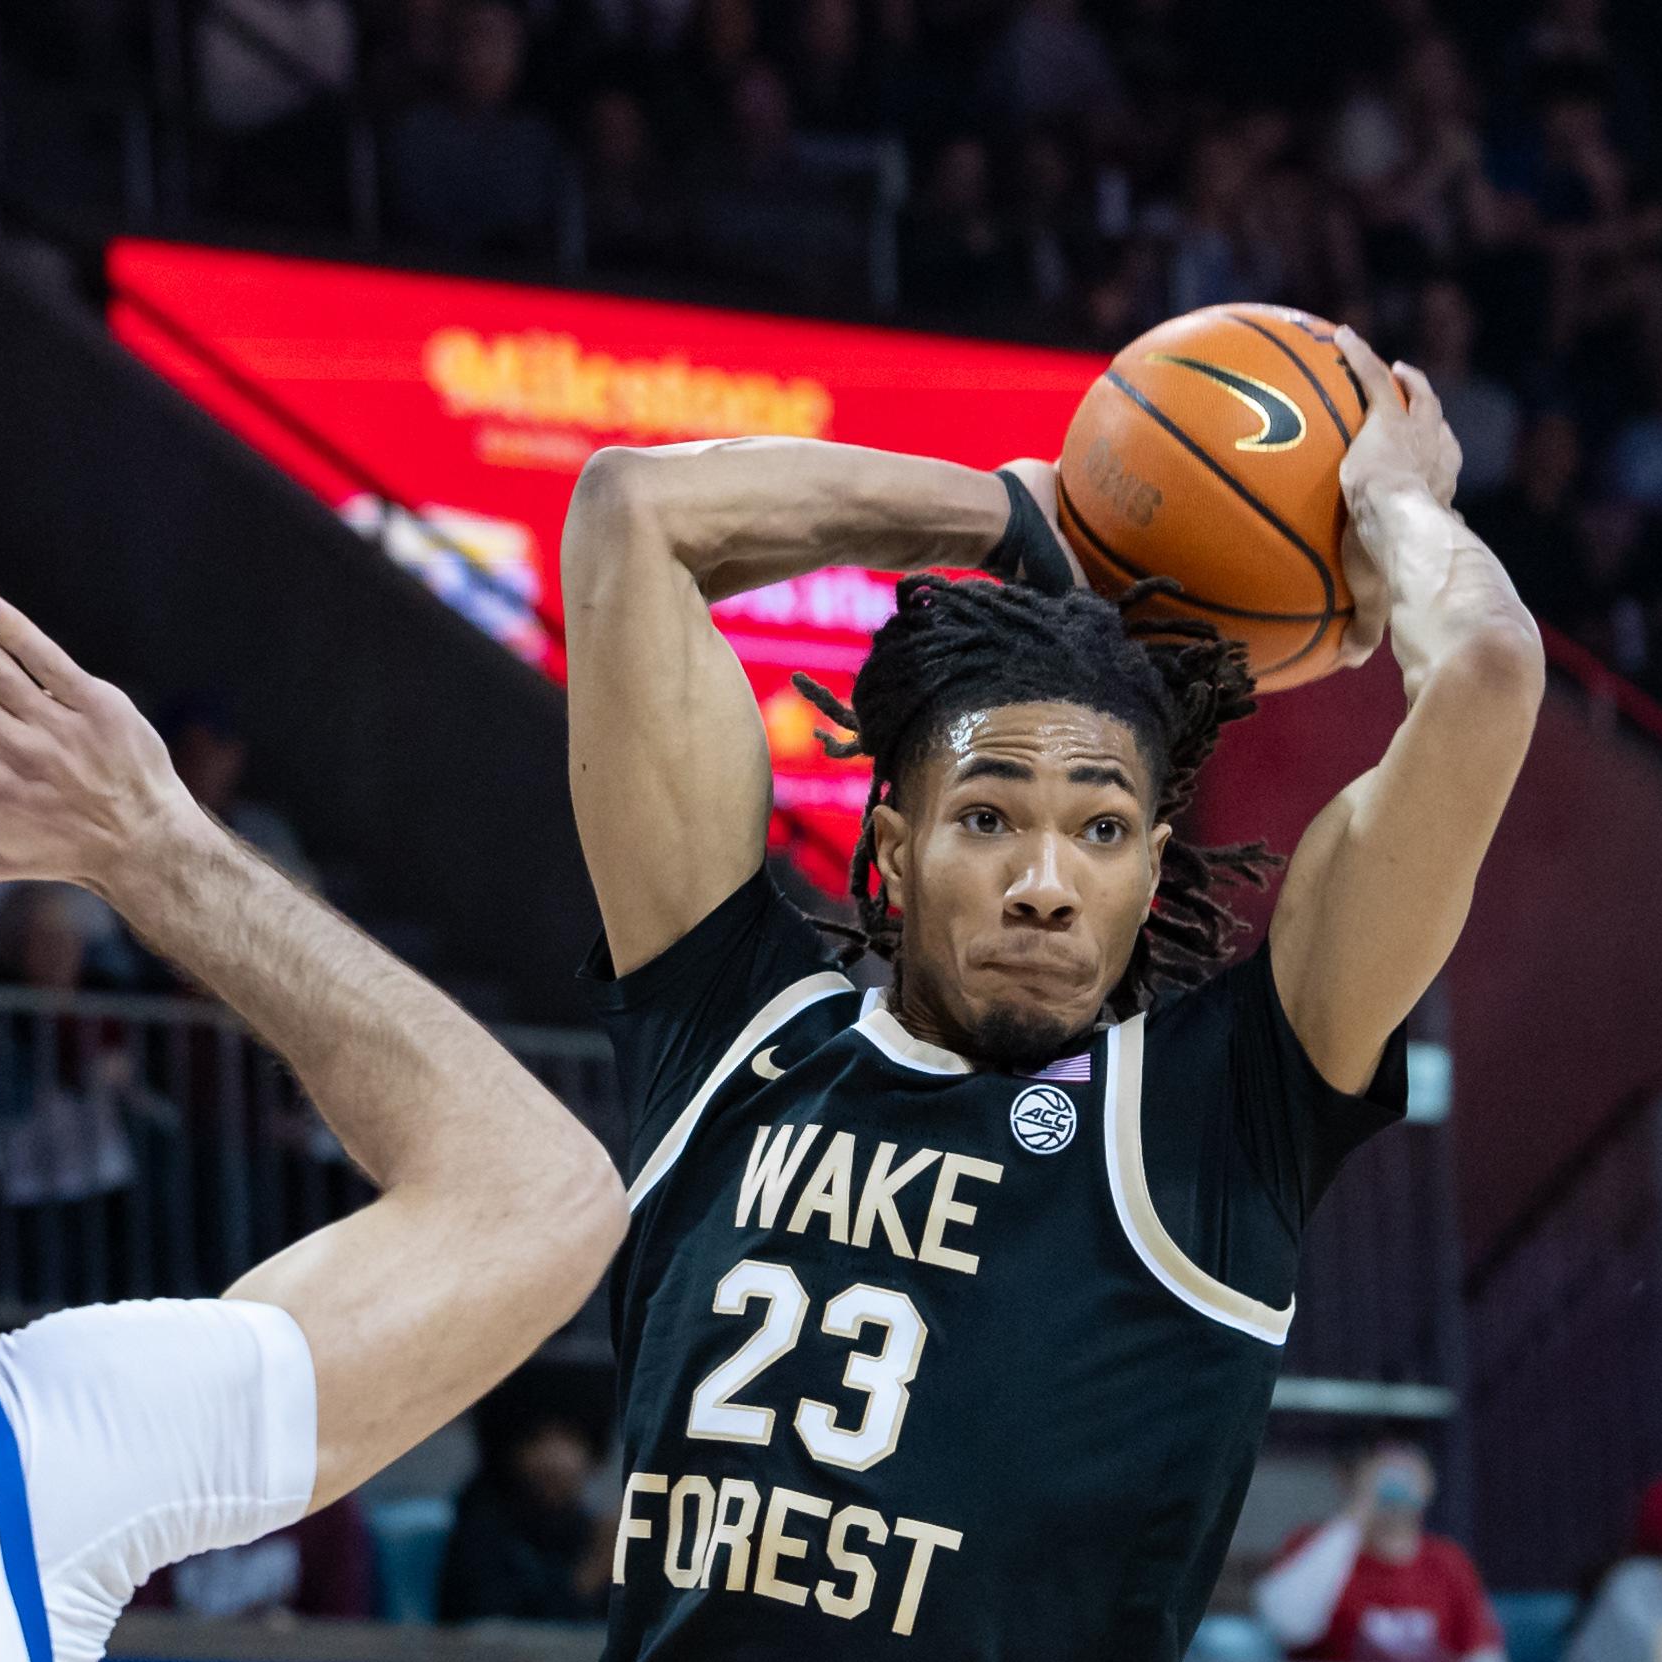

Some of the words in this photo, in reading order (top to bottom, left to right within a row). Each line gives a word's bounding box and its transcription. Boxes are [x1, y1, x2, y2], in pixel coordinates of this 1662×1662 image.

[1021, 1106, 1073, 1132] ACC
[734, 1124, 1005, 1276] WAKE
[687, 1259, 928, 1472] 23
[613, 1472, 963, 1637] FOREST
